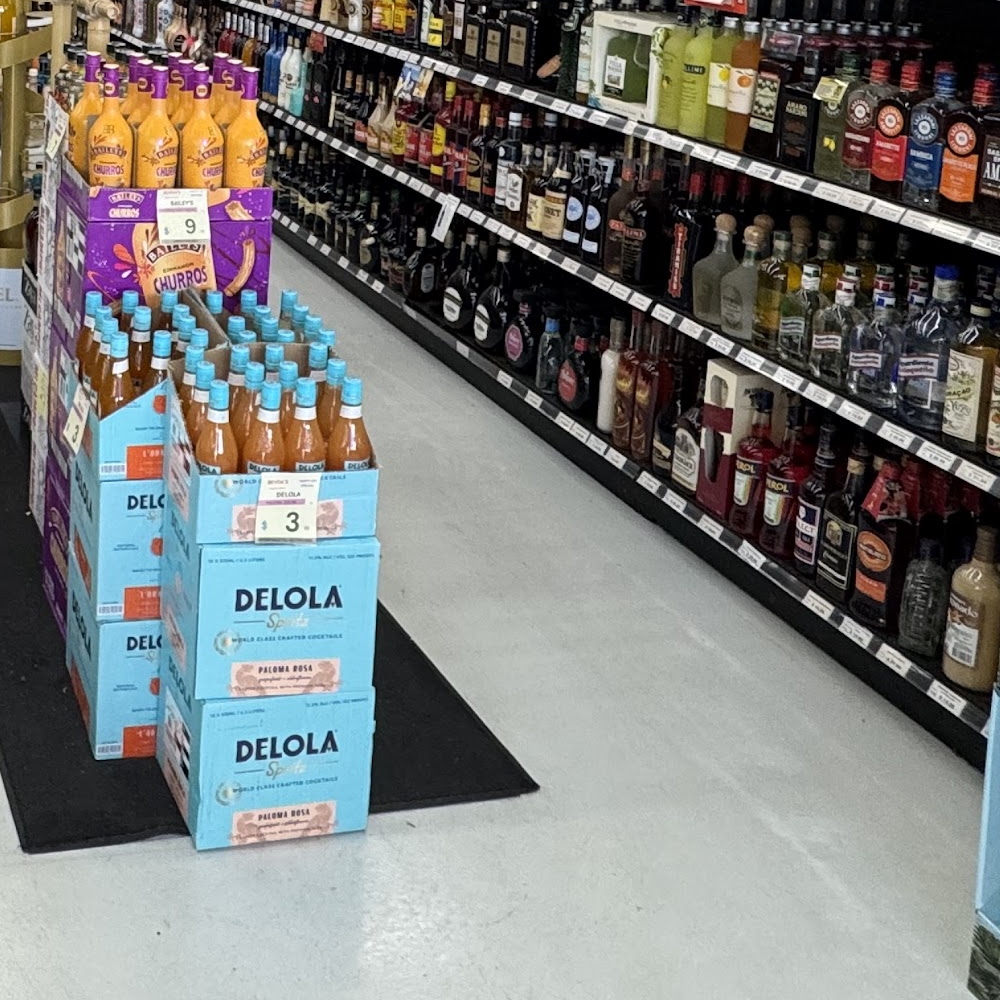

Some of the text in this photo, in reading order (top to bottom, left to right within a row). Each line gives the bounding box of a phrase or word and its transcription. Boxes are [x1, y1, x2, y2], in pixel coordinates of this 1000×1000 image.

[93, 164, 124, 176] CHURROS
[108, 207, 140, 219] CHURROS
[185, 218, 197, 234] 9
[153, 265, 208, 294] CHURROS
[285, 511, 300, 533] 3
[234, 585, 343, 612] DELOLA
[258, 664, 313, 674] PALOMA ROSA
[235, 730, 339, 764] DELOLA
[256, 783, 276, 791] CLASS
[277, 780, 304, 788] CRAFTED
[305, 776, 339, 786] COCKTAILS
[257, 808, 311, 822] PALOMA ROSA
